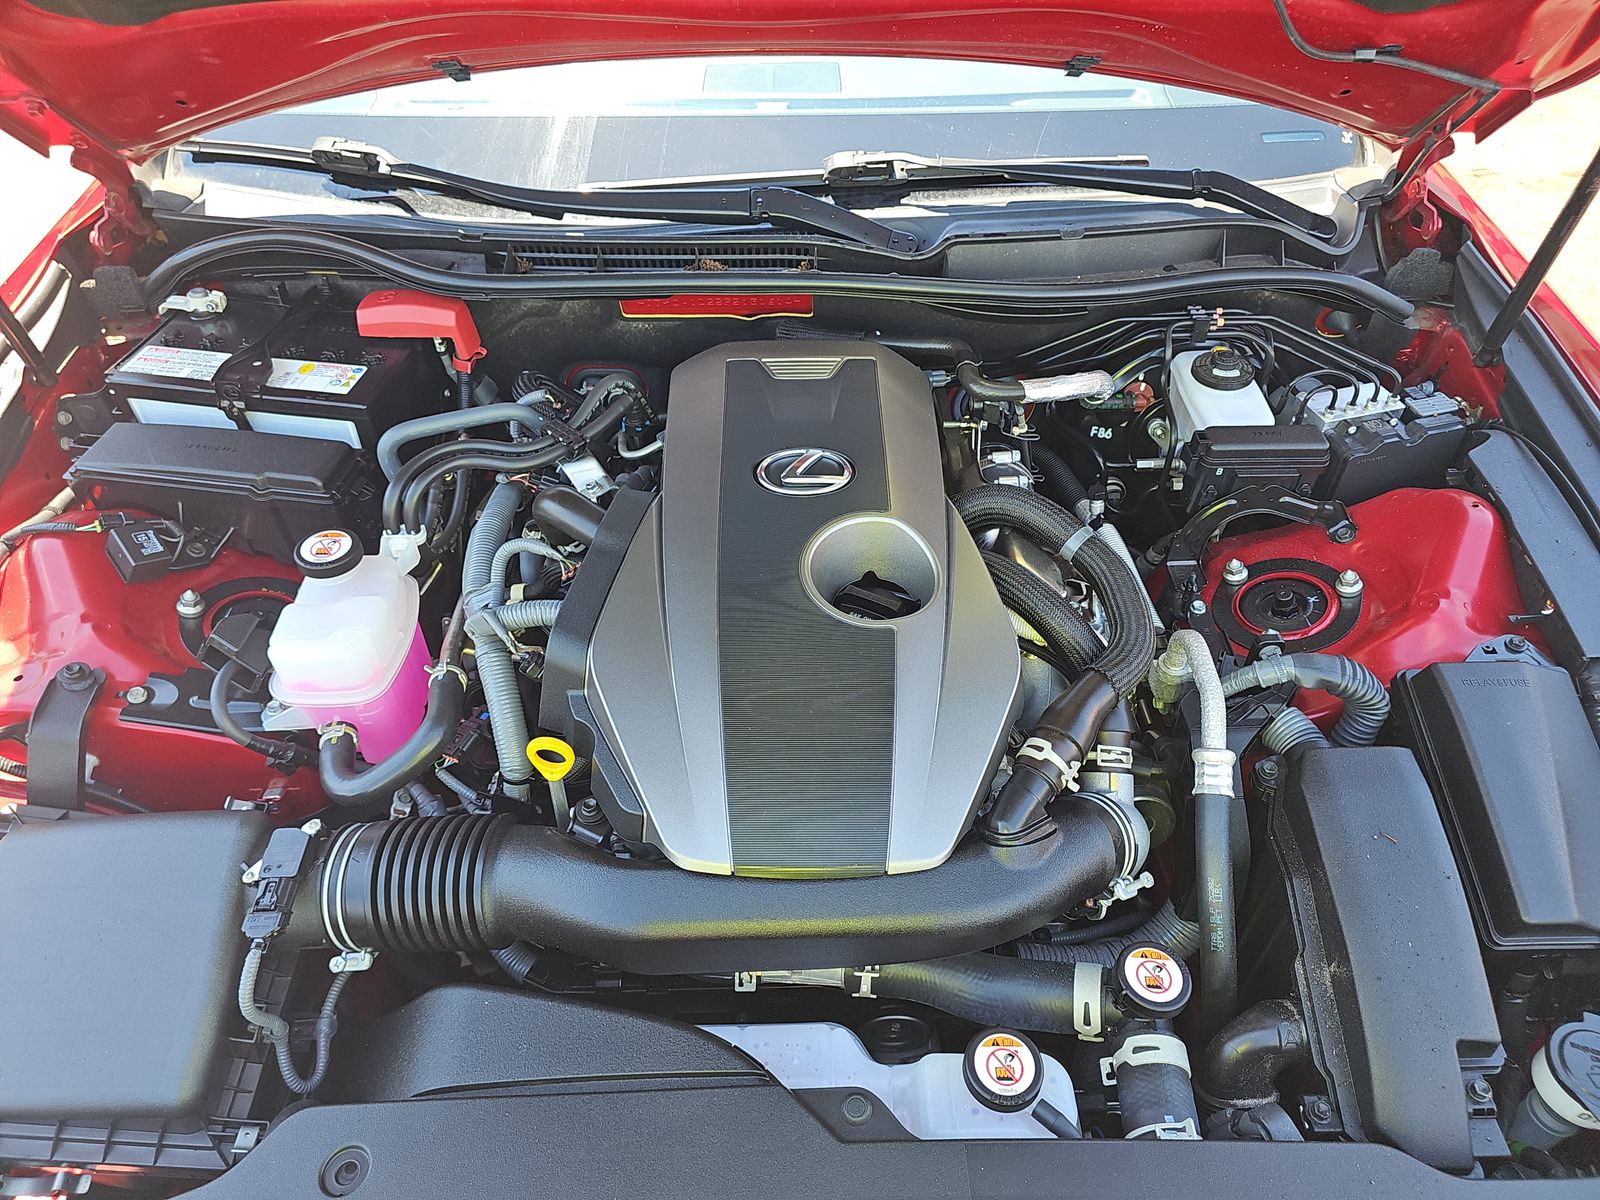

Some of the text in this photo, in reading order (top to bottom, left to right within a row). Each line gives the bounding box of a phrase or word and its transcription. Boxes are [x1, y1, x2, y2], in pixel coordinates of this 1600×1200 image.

[1089, 425, 1113, 440] F86
[1215, 467, 1224, 476] B
[1460, 677, 1533, 688] RELAY&FUSE
